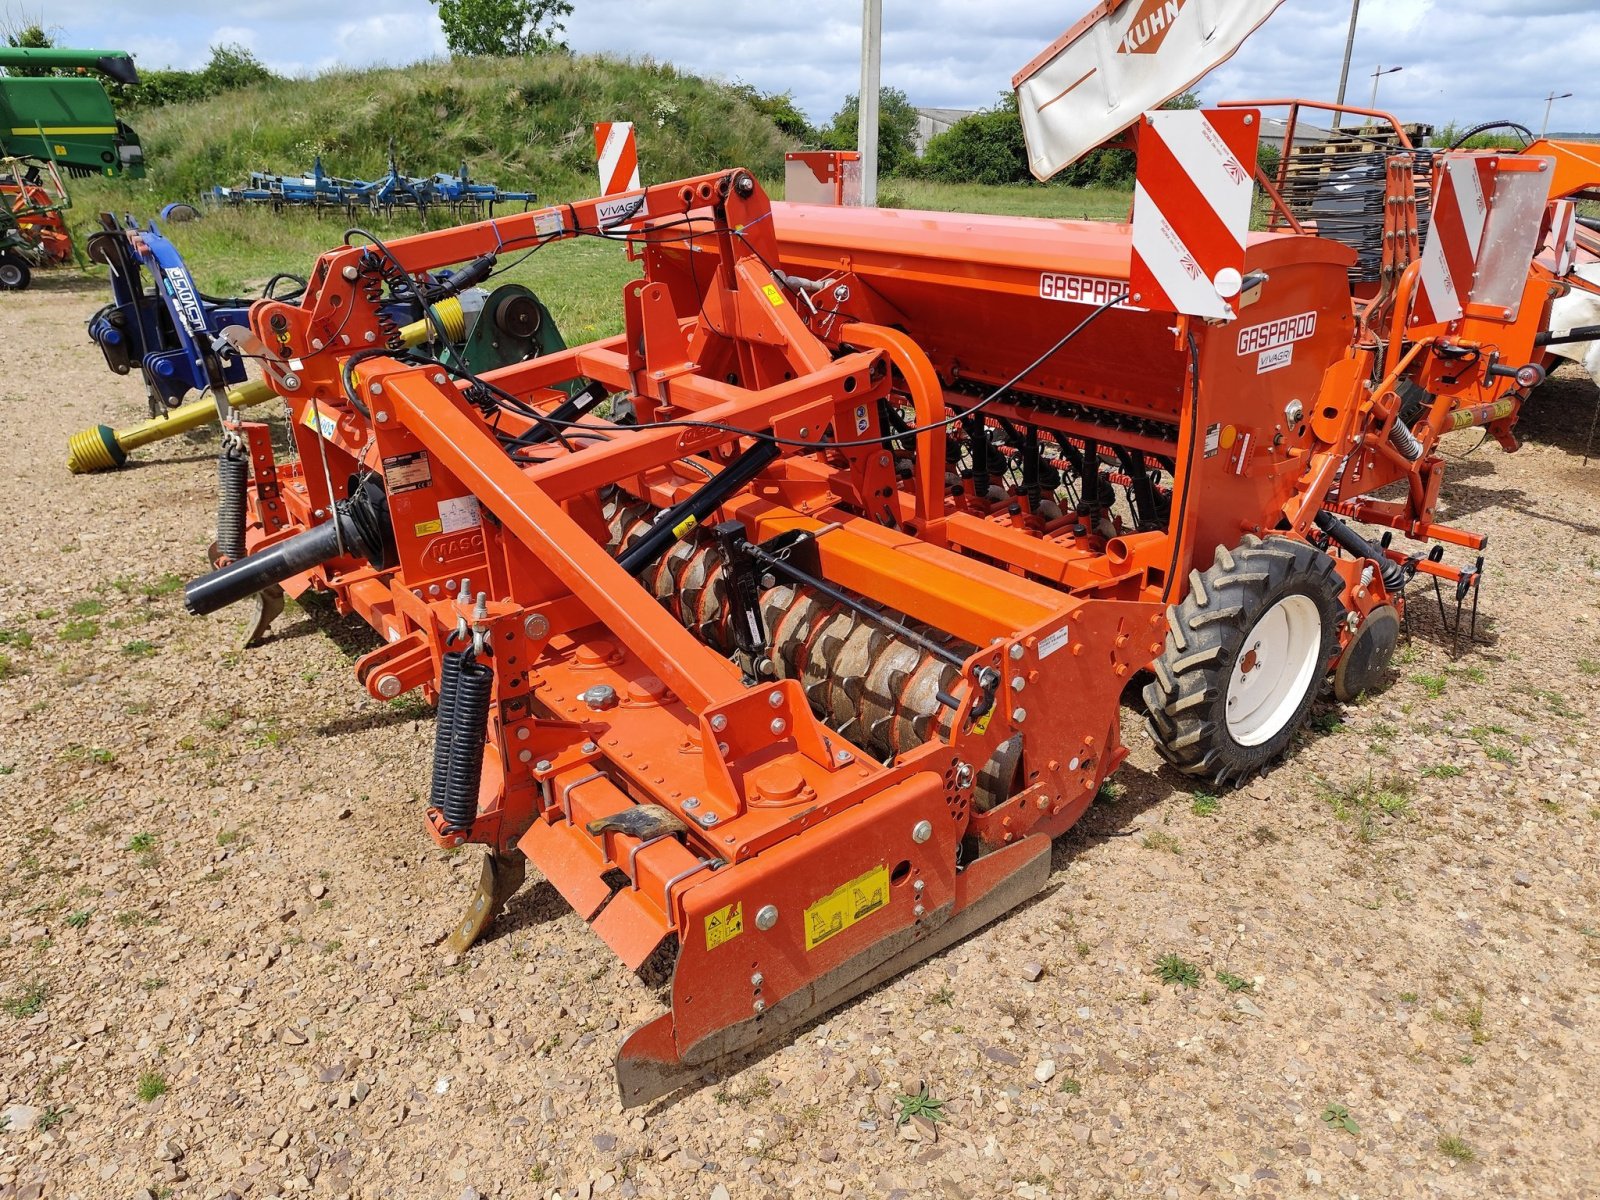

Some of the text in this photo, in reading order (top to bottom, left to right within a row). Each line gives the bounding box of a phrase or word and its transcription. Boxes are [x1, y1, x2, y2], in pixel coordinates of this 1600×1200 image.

[1122, 0, 1180, 56] KUHN
[1041, 274, 1130, 307] GASPARD
[1238, 313, 1316, 354] GASPARDO
